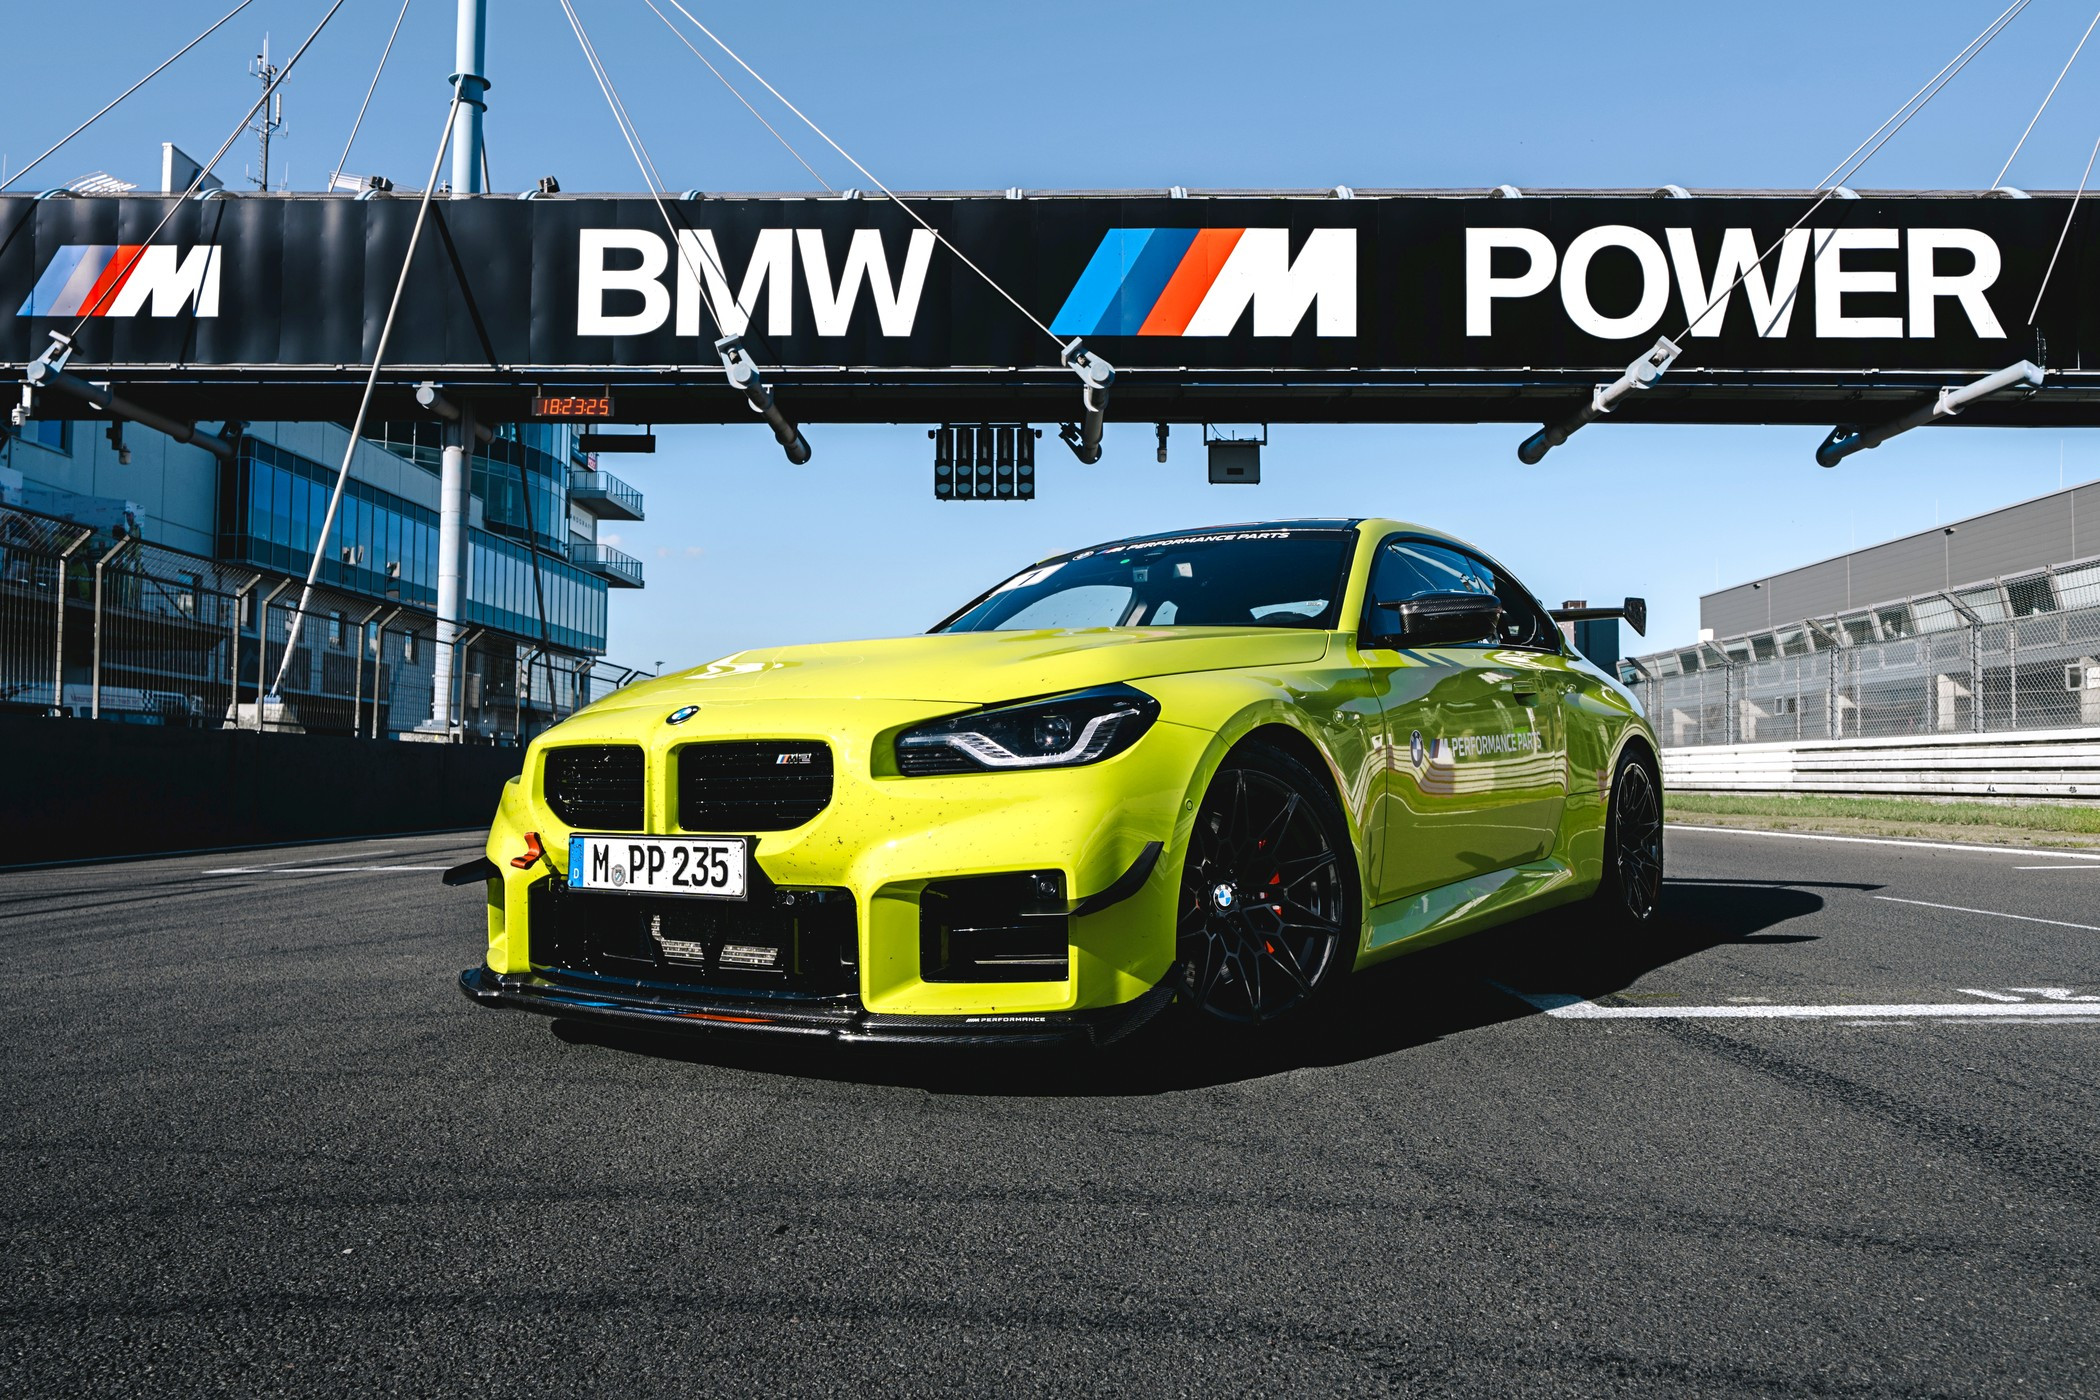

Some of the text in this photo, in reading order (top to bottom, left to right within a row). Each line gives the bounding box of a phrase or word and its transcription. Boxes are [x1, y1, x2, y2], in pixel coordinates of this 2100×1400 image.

[98, 244, 222, 317] M
[577, 225, 2008, 340] BMW M POWER
[543, 398, 609, 415] 18:23:25
[1126, 534, 1237, 551] PERFORMANCE
[1237, 532, 1291, 540] PARTS
[1452, 733, 1517, 757] PERFORMANCE
[1518, 731, 1542, 750] PARTS
[573, 868, 580, 879] D
[592, 844, 729, 888] M PP 235
